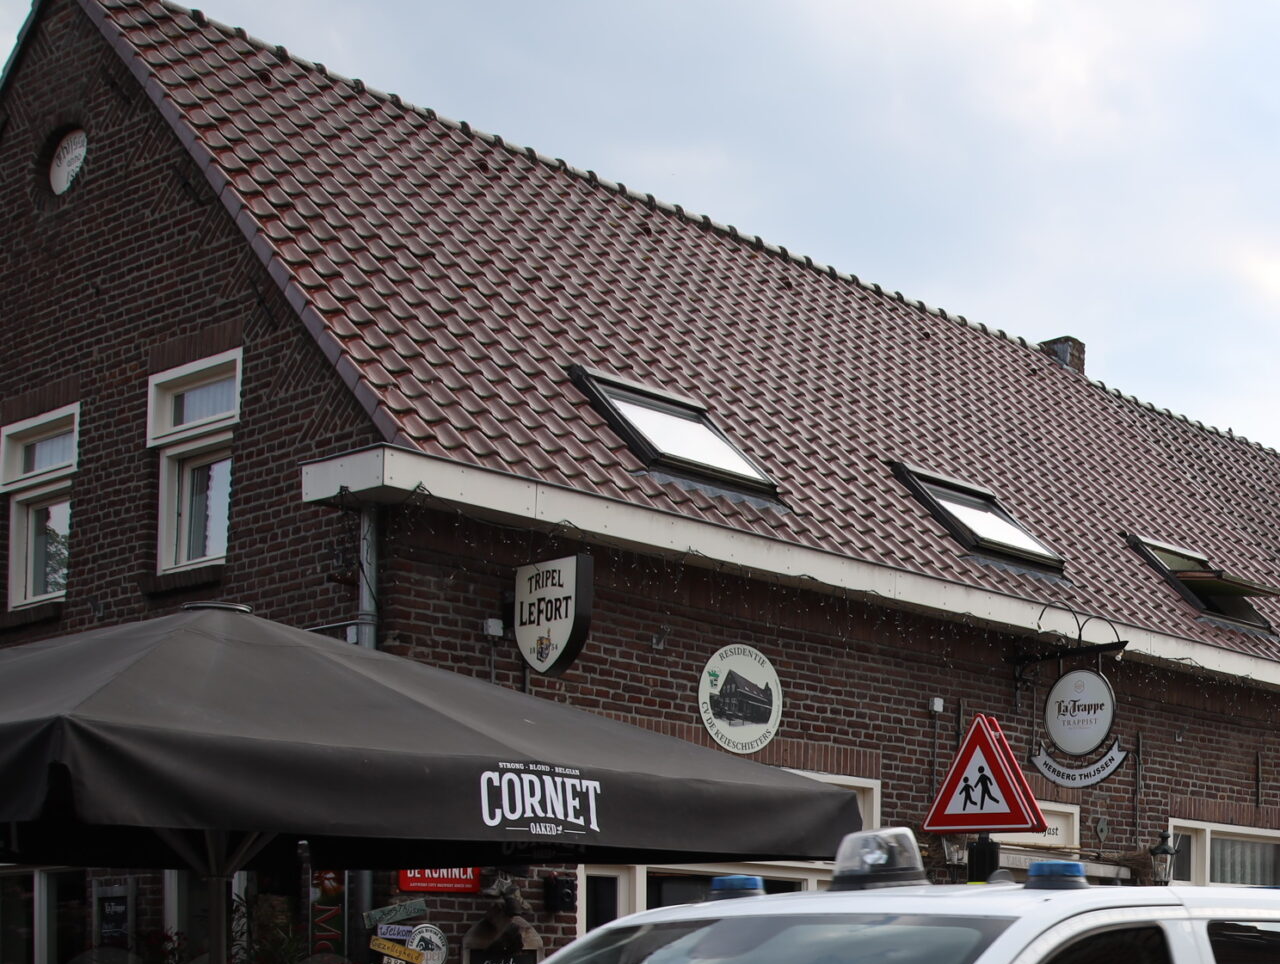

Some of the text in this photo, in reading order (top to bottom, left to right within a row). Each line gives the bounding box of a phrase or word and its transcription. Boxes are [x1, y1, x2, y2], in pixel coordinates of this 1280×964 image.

[528, 569, 564, 594] TRIPEL
[718, 646, 768, 668] RESIDENTIE
[1069, 698, 1105, 718] Trappe
[701, 701, 773, 752] CV DE KEIESCHIETERS
[1062, 718, 1097, 728] TRAPPIST
[498, 761, 580, 776] STRONG BLOND BELGIAN
[1042, 755, 1116, 781] HERBERG THIJSSEN
[480, 770, 601, 833] CORNET
[529, 822, 557, 835] OAKED
[380, 925, 413, 937] Welkom
[371, 938, 421, 961] Gezelligheid
